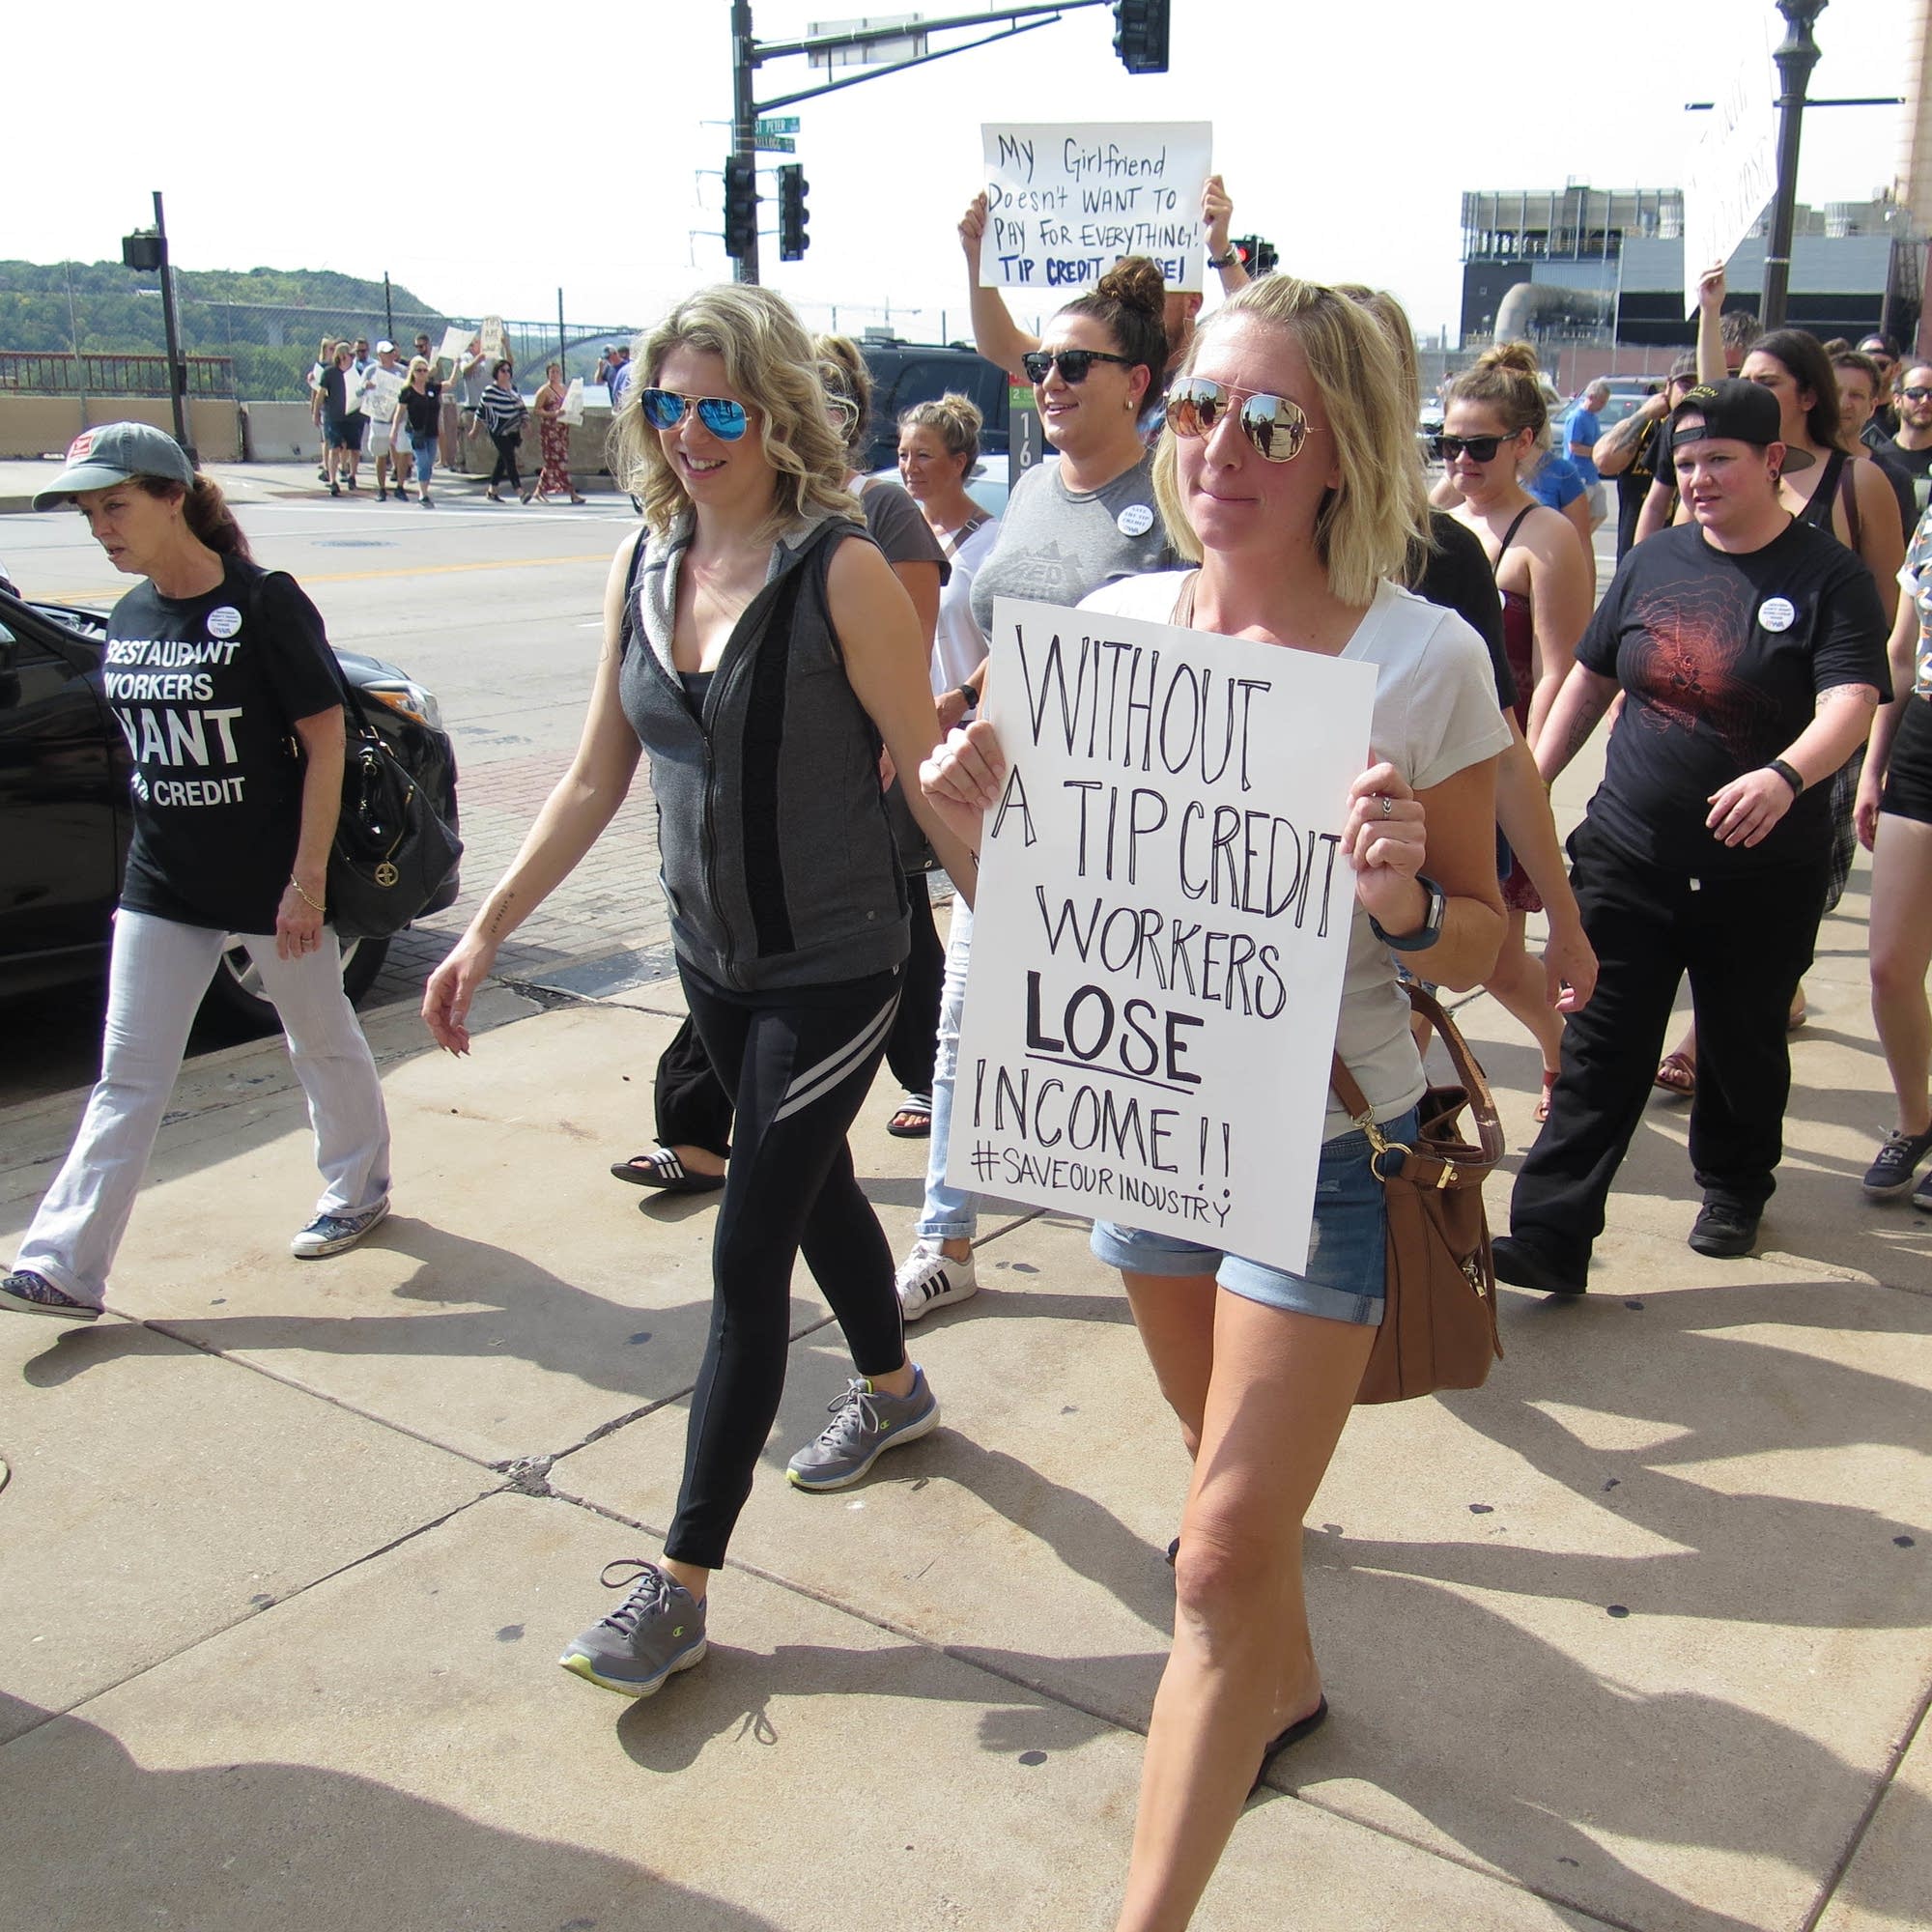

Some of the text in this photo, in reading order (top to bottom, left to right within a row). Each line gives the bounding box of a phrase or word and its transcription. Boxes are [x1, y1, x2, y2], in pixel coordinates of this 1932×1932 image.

[998, 134, 1165, 184] My Girlfriend
[988, 183, 1177, 214] Doesn't WANT TO
[994, 217, 1200, 255] PAY FOR EVERYTHING!
[999, 254, 1035, 283] TIP
[1046, 257, 1104, 285] CREDIT
[104, 639, 241, 668] RESTAURANT
[104, 672, 213, 701] WORKERS
[1015, 624, 1271, 792] WITHOUT
[154, 777, 245, 807] CREDIT
[991, 764, 1342, 938] A TIP CREDIT
[1036, 885, 1287, 1019] WORKERS
[1026, 971, 1204, 1084] LOSE
